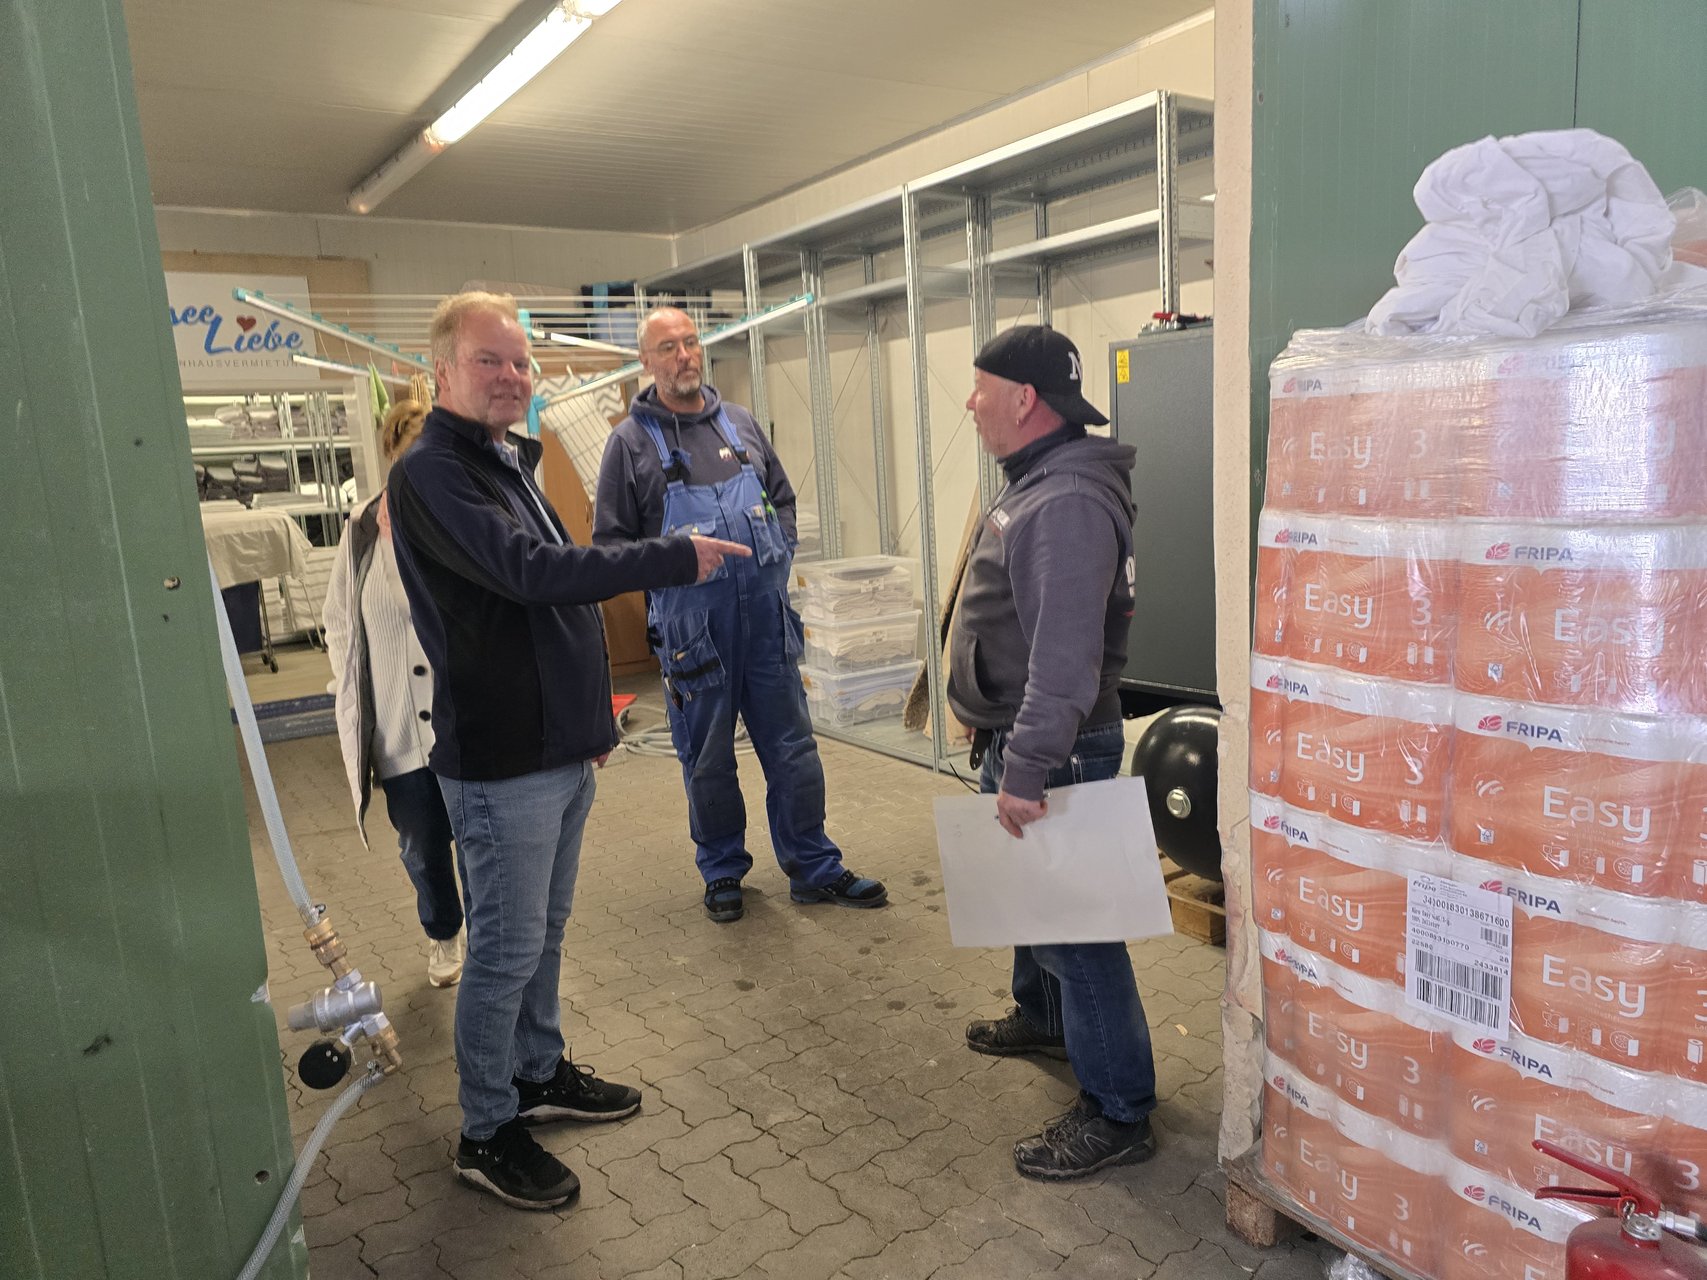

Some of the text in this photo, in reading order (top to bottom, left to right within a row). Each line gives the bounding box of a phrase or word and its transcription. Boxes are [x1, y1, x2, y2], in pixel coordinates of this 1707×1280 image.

[203, 314, 304, 355] Liebe
[1310, 431, 1373, 469] Easy
[1514, 546, 1574, 561] FRIPA
[1304, 583, 1432, 629] Easy 3
[1554, 608, 1666, 658] Easy
[1506, 720, 1563, 743] FRIPA
[1297, 732, 1365, 782] Easy
[1543, 785, 1651, 843] Easy
[1300, 876, 1364, 931] Easy
[1507, 887, 1561, 914] FRIPA
[1542, 953, 1646, 1018] Easy
[1309, 1011, 1420, 1084] Esy 3
[1500, 1046, 1553, 1078] FRIPA
[1301, 1138, 1358, 1201] Eay
[1674, 1160, 1701, 1190] 3
[1488, 1196, 1542, 1231] FRIPA
